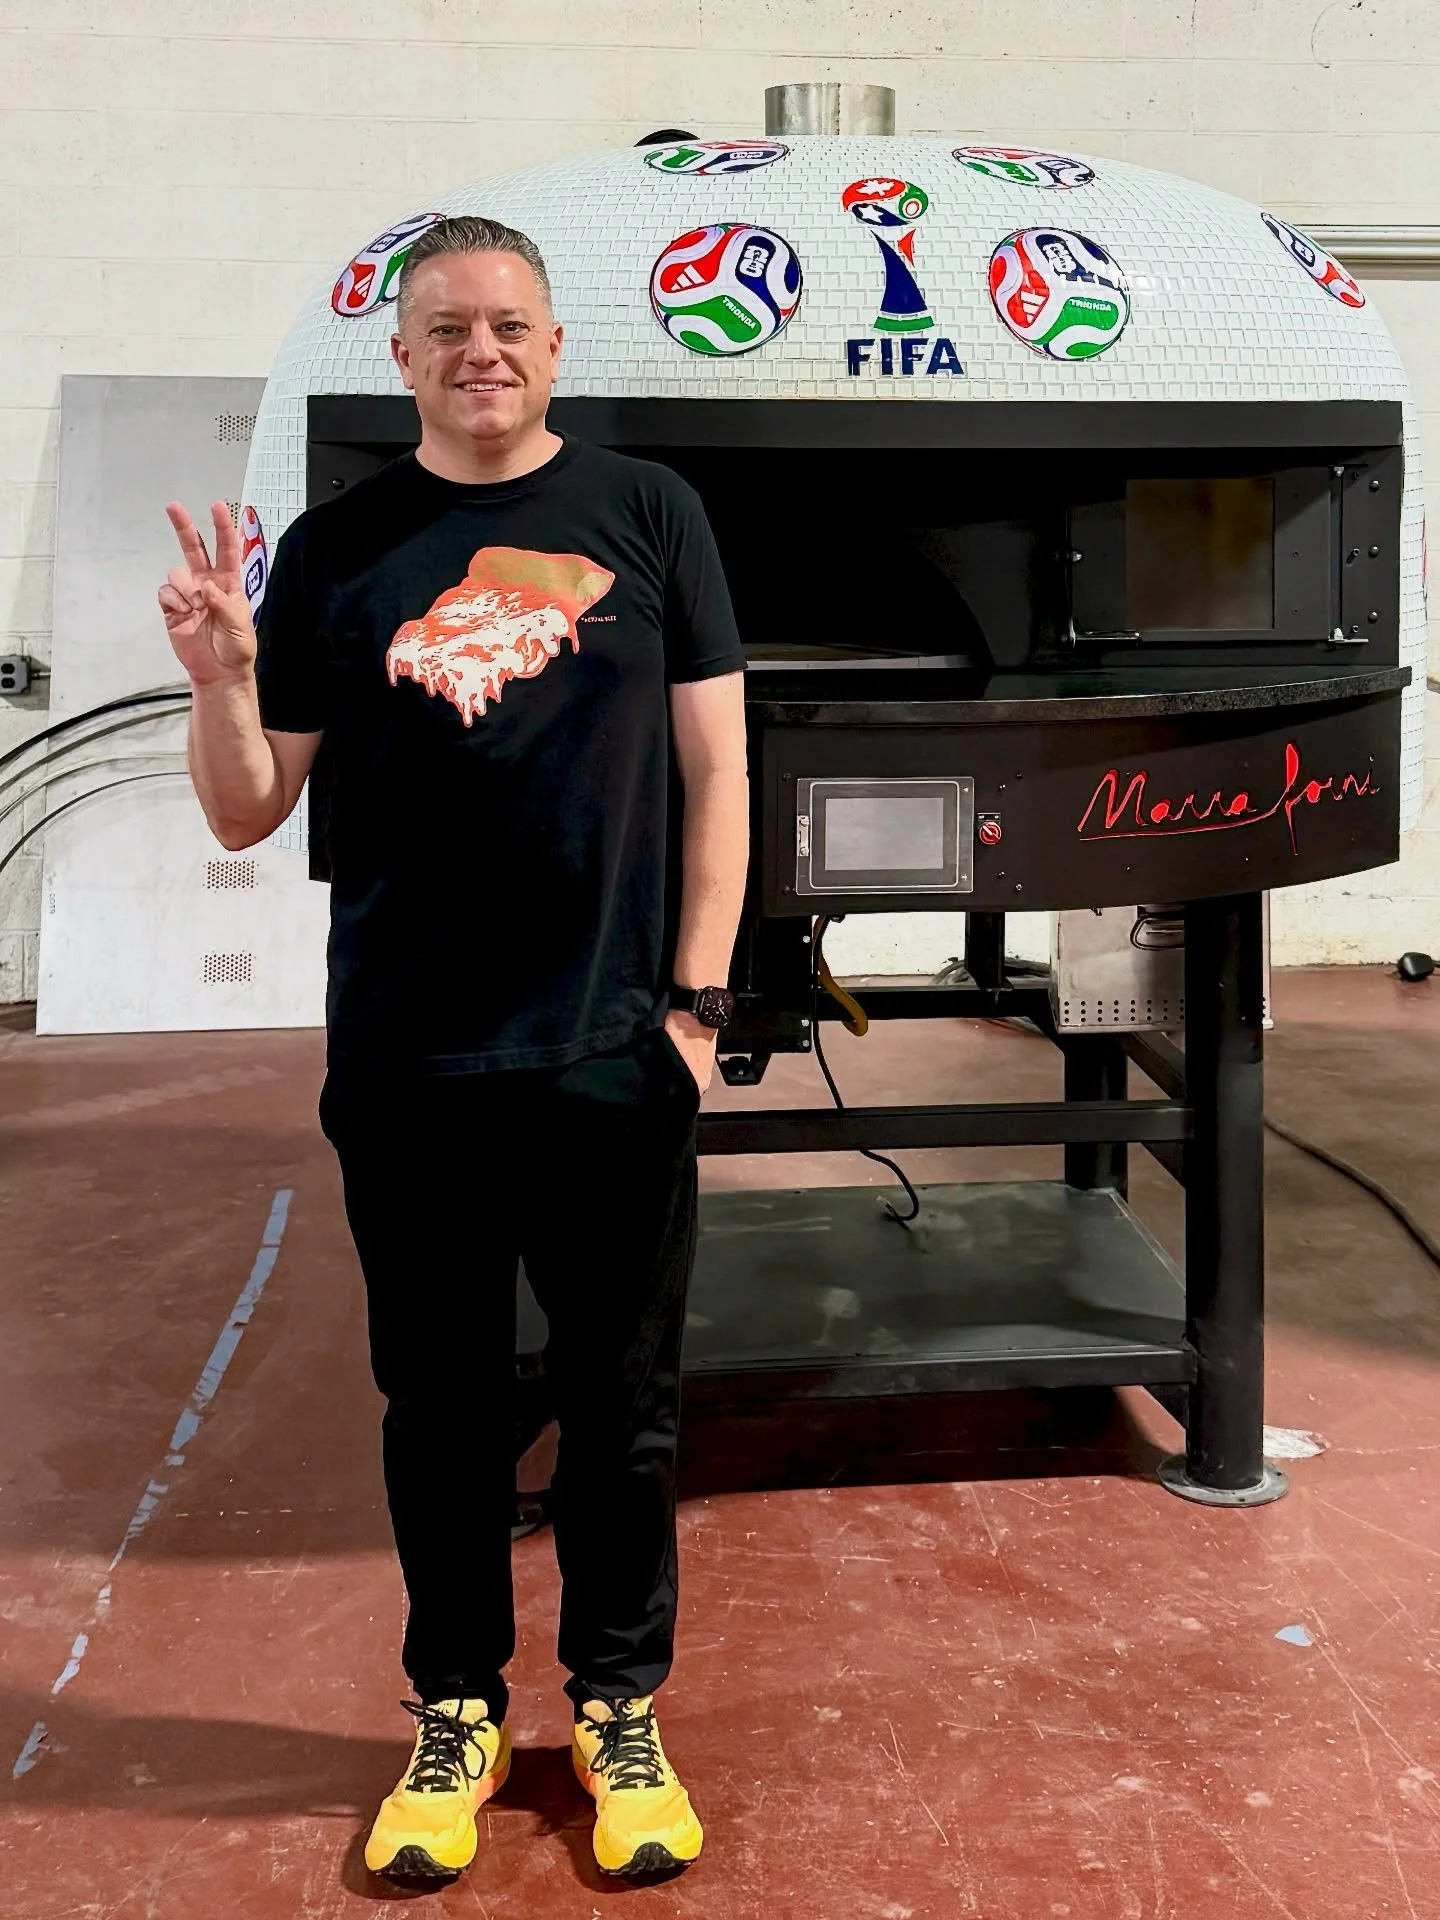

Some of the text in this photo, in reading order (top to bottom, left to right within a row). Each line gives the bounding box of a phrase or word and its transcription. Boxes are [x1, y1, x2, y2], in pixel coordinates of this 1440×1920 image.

[722, 296, 757, 330] TRIONDA
[1069, 298, 1112, 312] TRIONDA
[846, 338, 965, 376] FIFA
